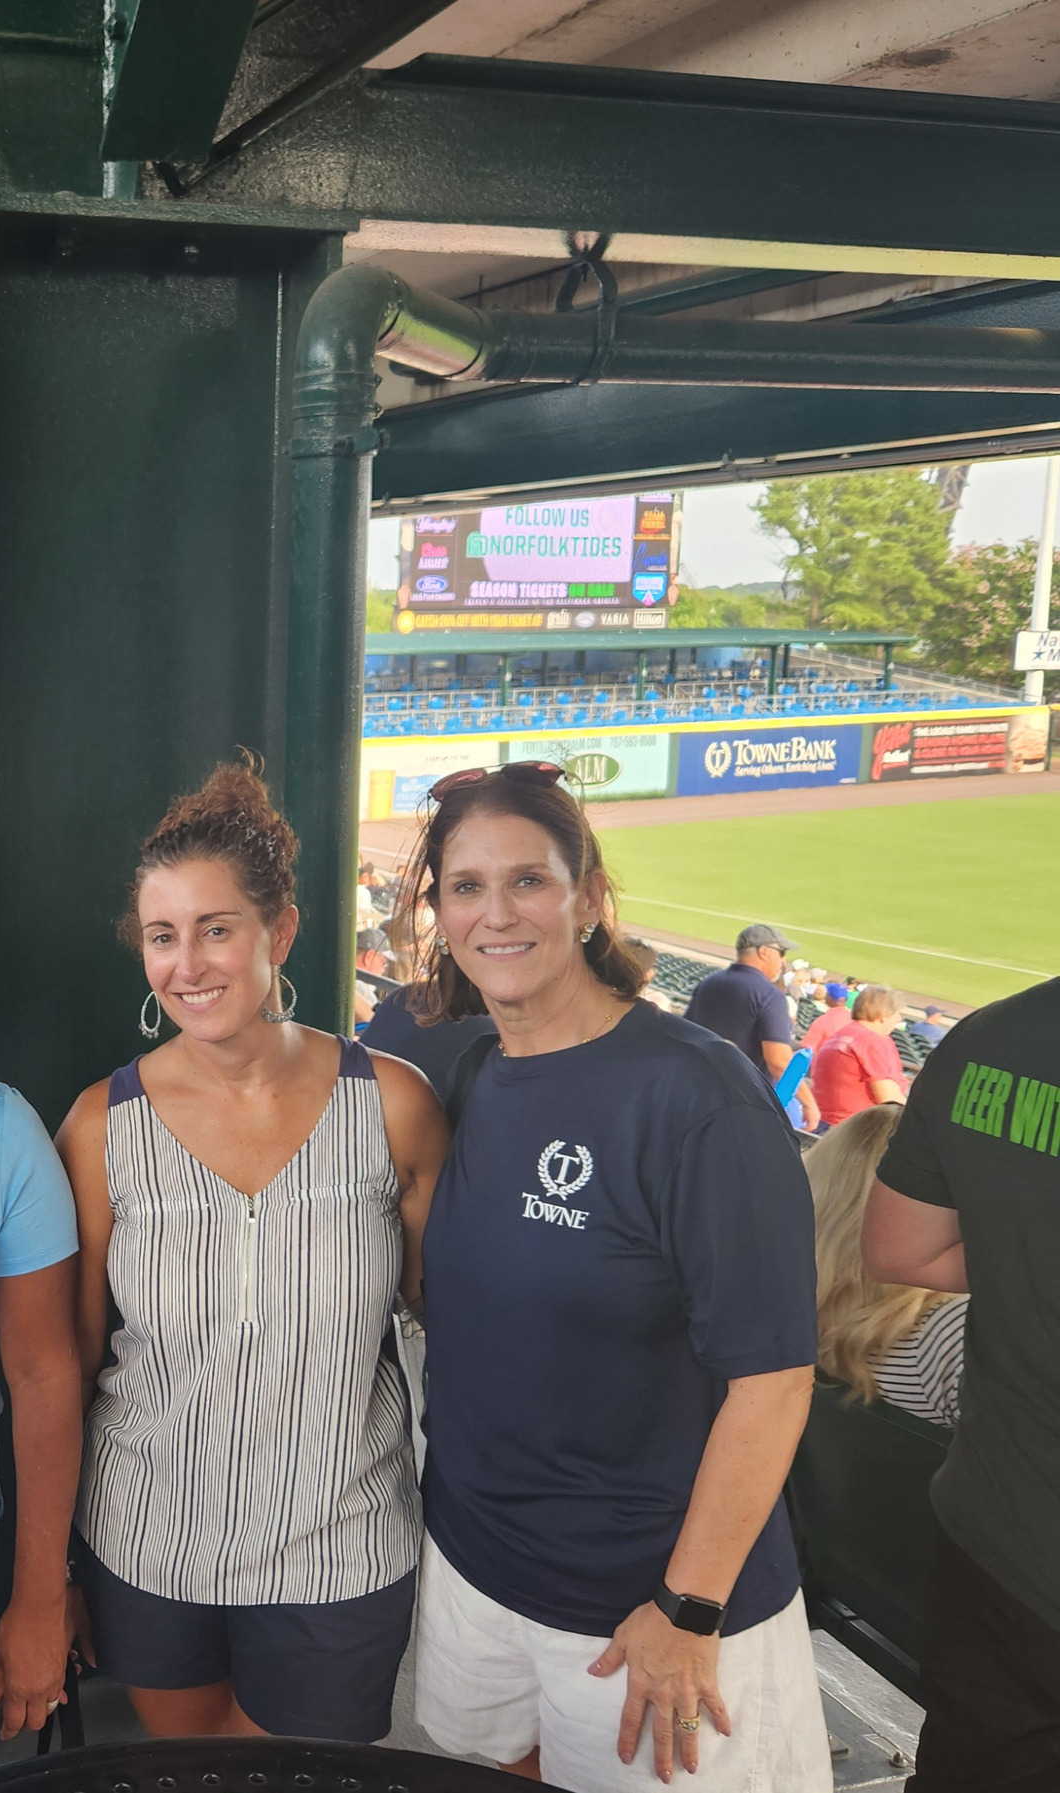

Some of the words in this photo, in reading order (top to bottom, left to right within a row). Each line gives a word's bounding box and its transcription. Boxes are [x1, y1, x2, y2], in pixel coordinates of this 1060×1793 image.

[506, 506, 566, 527] FOLLOW
[570, 509, 589, 527] US
[470, 581, 518, 598] SEASON
[519, 582, 568, 598] TICKETS
[572, 755, 609, 785] ALM
[950, 1061, 1014, 1138] BEER
